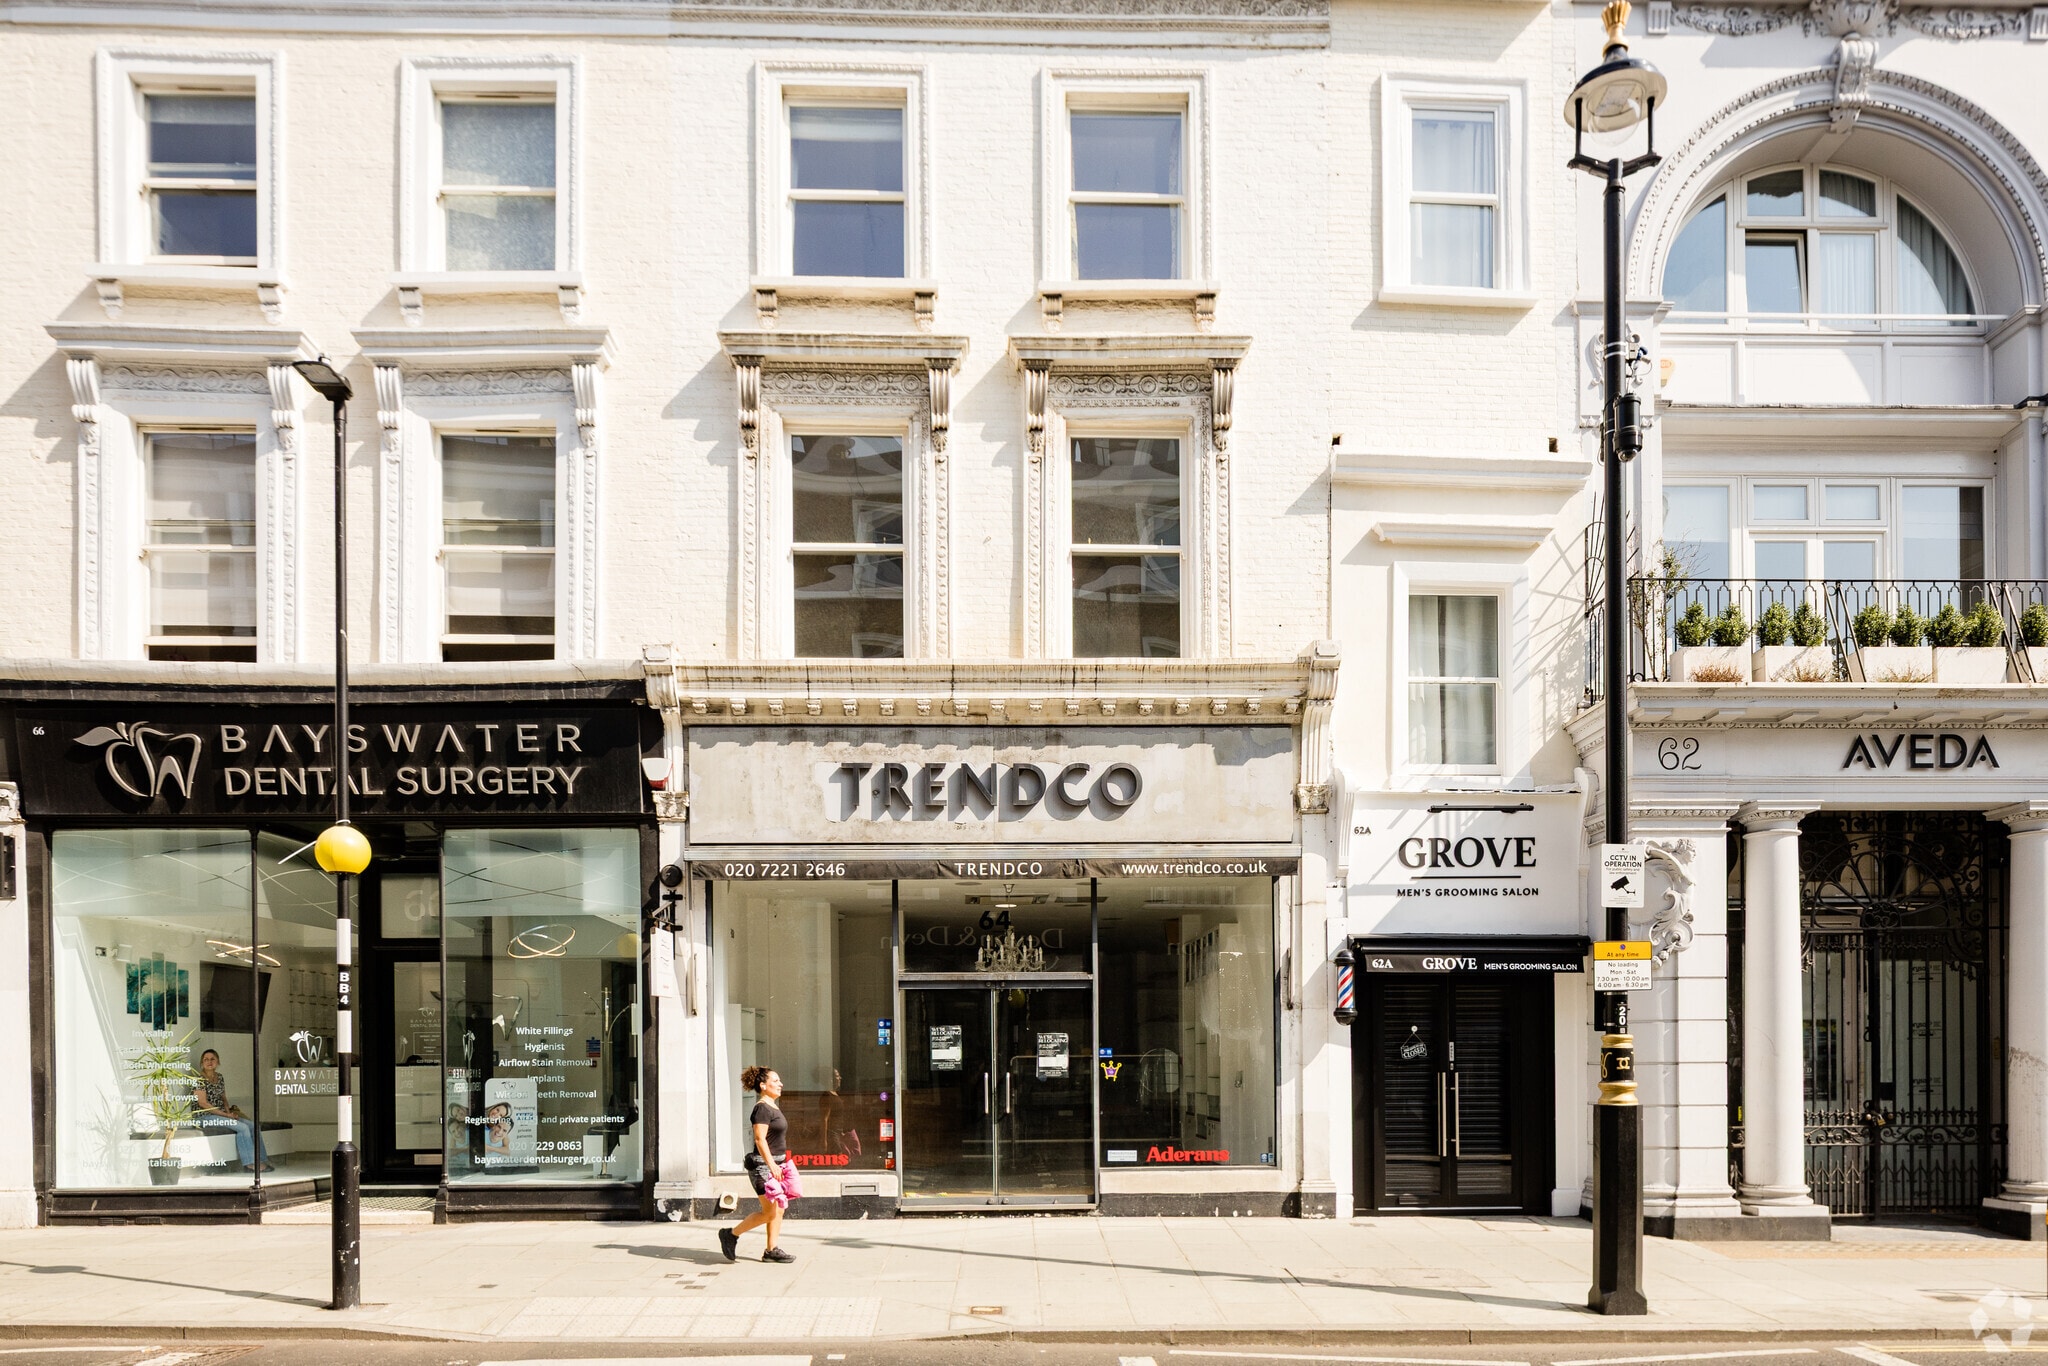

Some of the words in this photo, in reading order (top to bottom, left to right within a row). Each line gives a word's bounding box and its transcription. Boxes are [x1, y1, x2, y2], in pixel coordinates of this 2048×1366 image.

[32, 726, 45, 736] 66
[220, 724, 583, 753] BAYSWATER
[1657, 737, 1702, 770] 62
[1843, 734, 2000, 769] AVEDA
[224, 767, 384, 795] DENTAL
[396, 766, 583, 795] SURGERY
[841, 762, 1143, 807] TRENDCO
[1353, 826, 1372, 835] 62A
[1398, 837, 1537, 869] GROVE
[725, 863, 755, 877] 020
[760, 863, 798, 877] 7221
[805, 863, 846, 876] 2646
[955, 862, 1043, 876] TRENDCO
[1121, 860, 1268, 875] www.trendco.co.uk
[1397, 888, 1431, 897] MEN'S
[1435, 888, 1498, 896] GROOMING
[1502, 888, 1539, 896] SALON
[979, 910, 1011, 931] 64
[1372, 958, 1394, 969] 62A
[1422, 957, 1478, 970] GROVE
[1552, 963, 1578, 971] SALON
[1619, 1006, 1627, 1026] 20
[132, 1029, 174, 1039] Invisalign
[516, 1027, 542, 1035] White
[543, 1026, 574, 1037] Fillings
[145, 1045, 191, 1053] Aesthetics
[524, 1042, 566, 1052] Hygienist
[145, 1061, 191, 1071] Whitening
[499, 1058, 530, 1067] Airflow
[531, 1058, 554, 1067] Stain
[556, 1058, 593, 1067] Removal
[161, 1077, 199, 1088] Bonding
[275, 1083, 309, 1095] DENTAL
[559, 1090, 597, 1099] Removal
[146, 1094, 164, 1102] and
[165, 1094, 199, 1102] Crowns
[170, 1118, 201, 1129] private
[203, 1117, 238, 1128] patients
[464, 1115, 512, 1126] Registering
[541, 1115, 558, 1124] and
[559, 1115, 588, 1126] private
[590, 1115, 625, 1126] patients
[529, 1142, 555, 1151] 7229
[556, 1141, 582, 1151] 0863
[474, 1153, 617, 1165] bayswaterdentalsurgery.co.uk
[1146, 1146, 1230, 1163] Aderans
